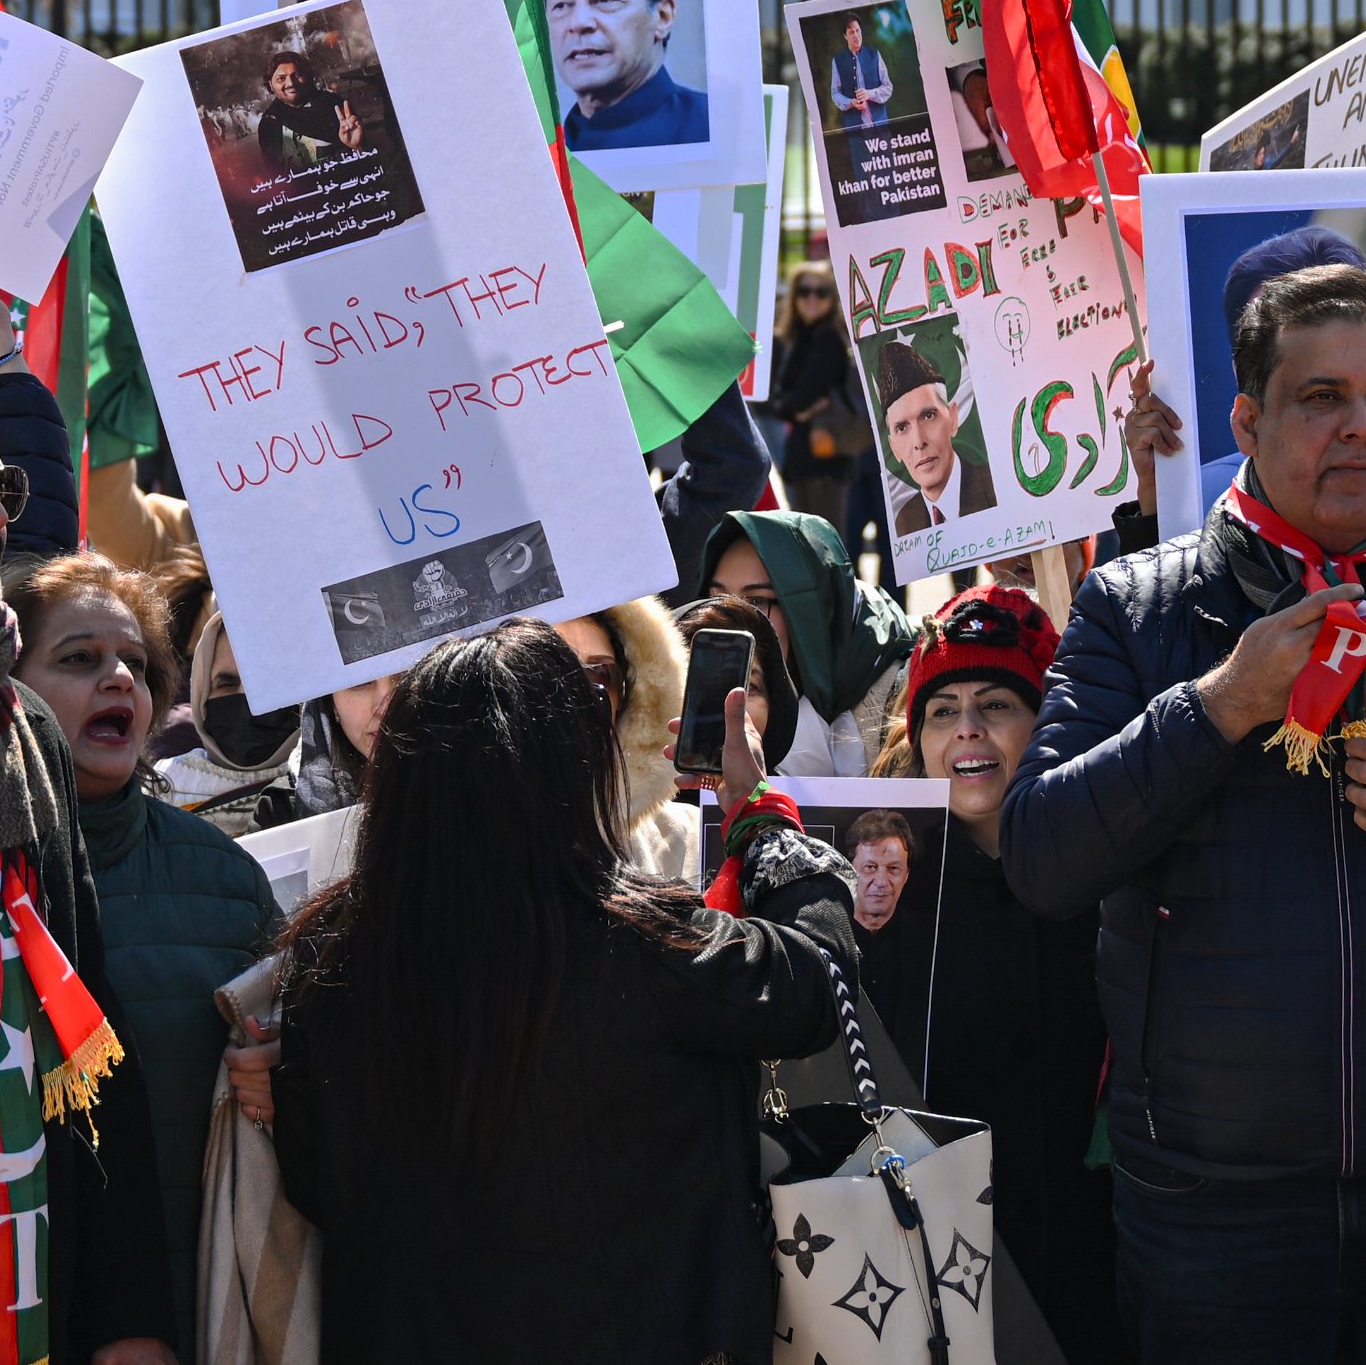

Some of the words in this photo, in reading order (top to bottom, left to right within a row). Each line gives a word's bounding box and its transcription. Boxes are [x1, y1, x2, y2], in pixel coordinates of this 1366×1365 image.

[865, 137, 887, 153] We
[890, 127, 931, 149] stand
[861, 155, 891, 173] with
[893, 148, 934, 167] imran
[838, 179, 869, 195] khan
[871, 174, 890, 189] for
[893, 166, 937, 185] better
[880, 183, 940, 205] Pakistan
[847, 236, 1002, 342] AZADI
[178, 340, 286, 412] THEY
[216, 413, 393, 493] WOULD
[428, 339, 609, 432] PROTECT
[926, 529, 944, 549] OF
